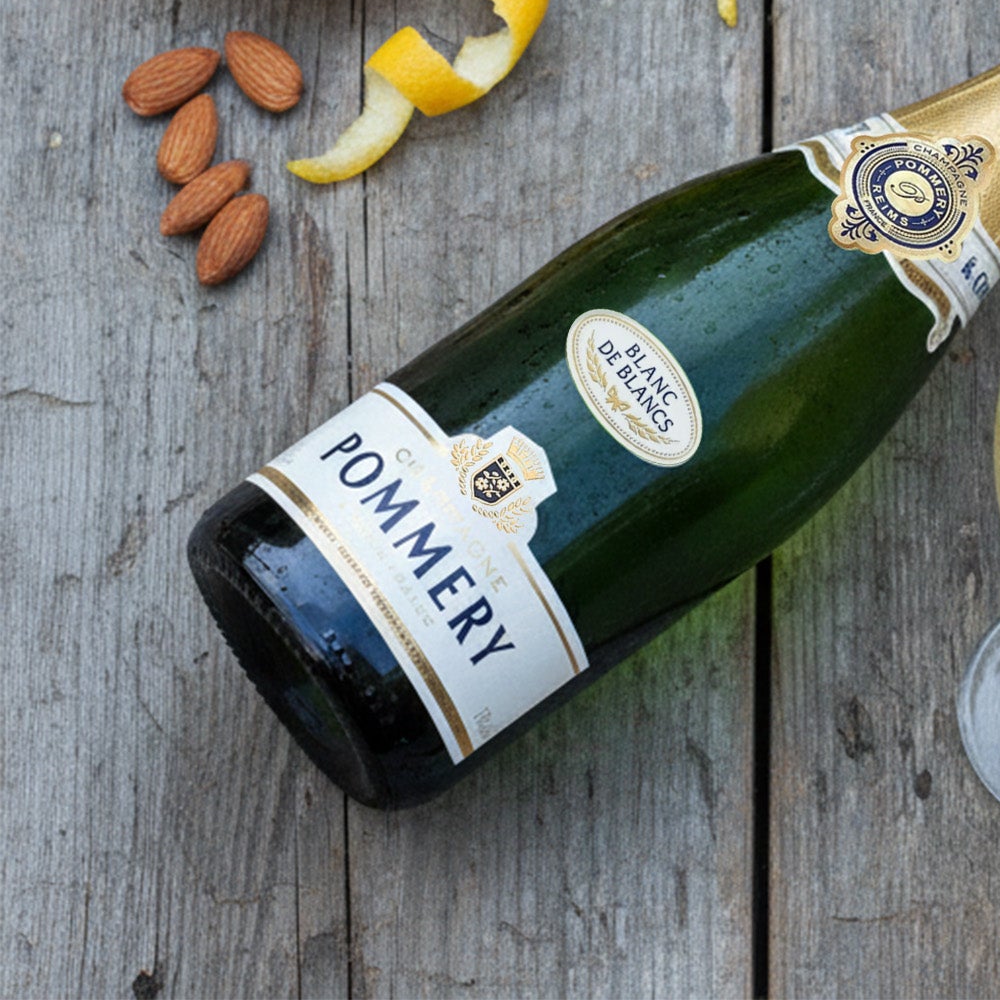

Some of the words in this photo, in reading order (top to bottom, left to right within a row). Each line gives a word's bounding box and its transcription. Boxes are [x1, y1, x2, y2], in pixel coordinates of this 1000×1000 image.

[872, 184, 909, 227] REIMS
[894, 159, 949, 219] POMMERY
[913, 144, 968, 207] CHAMPAGNE
[863, 199, 888, 229] FRANCE
[597, 340, 622, 366] DE
[616, 364, 674, 433] BLANCS
[625, 343, 678, 406] BLANC
[320, 432, 516, 666] POMMERY
